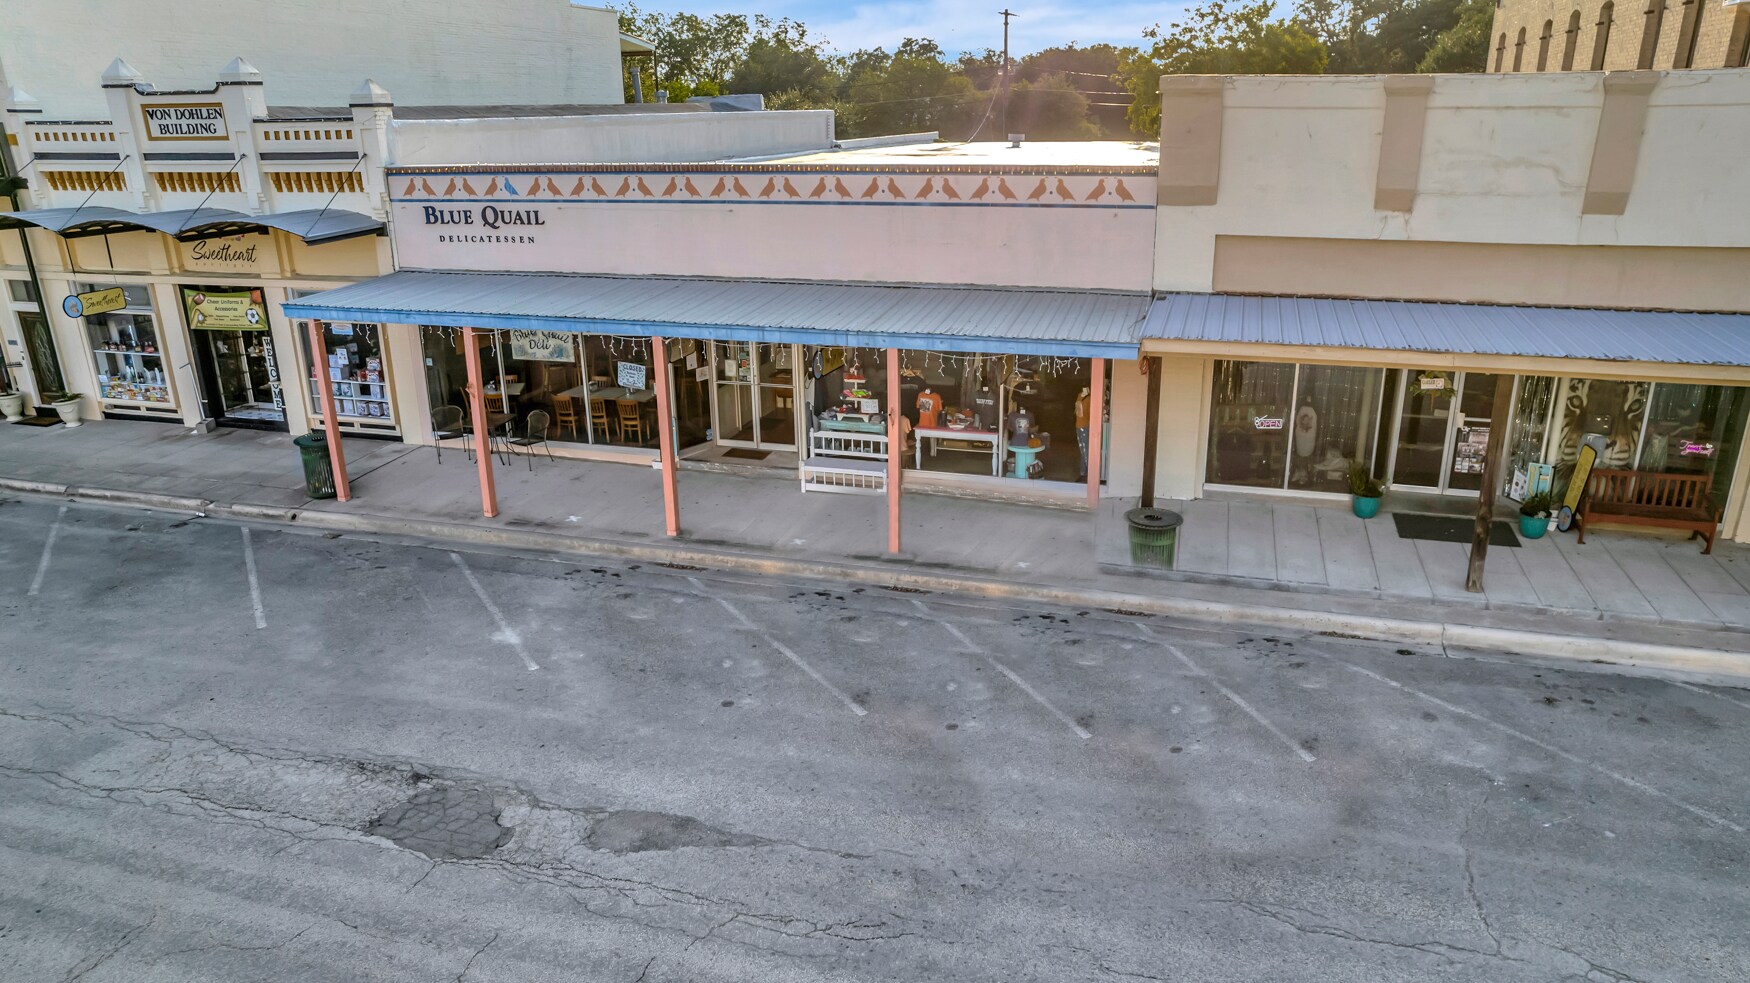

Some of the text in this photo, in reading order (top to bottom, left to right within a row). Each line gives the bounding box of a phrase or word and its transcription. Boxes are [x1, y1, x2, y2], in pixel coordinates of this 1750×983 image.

[145, 108, 223, 121] VON DOHLEN
[158, 123, 217, 135] BUILDING
[439, 235, 535, 244] DELICATESSEN
[191, 240, 257, 263] Sweetheart
[529, 339, 551, 350] Deli
[263, 338, 283, 409] WELCOME
[623, 363, 643, 373] CLOSED
[1259, 420, 1281, 428] OPEN
